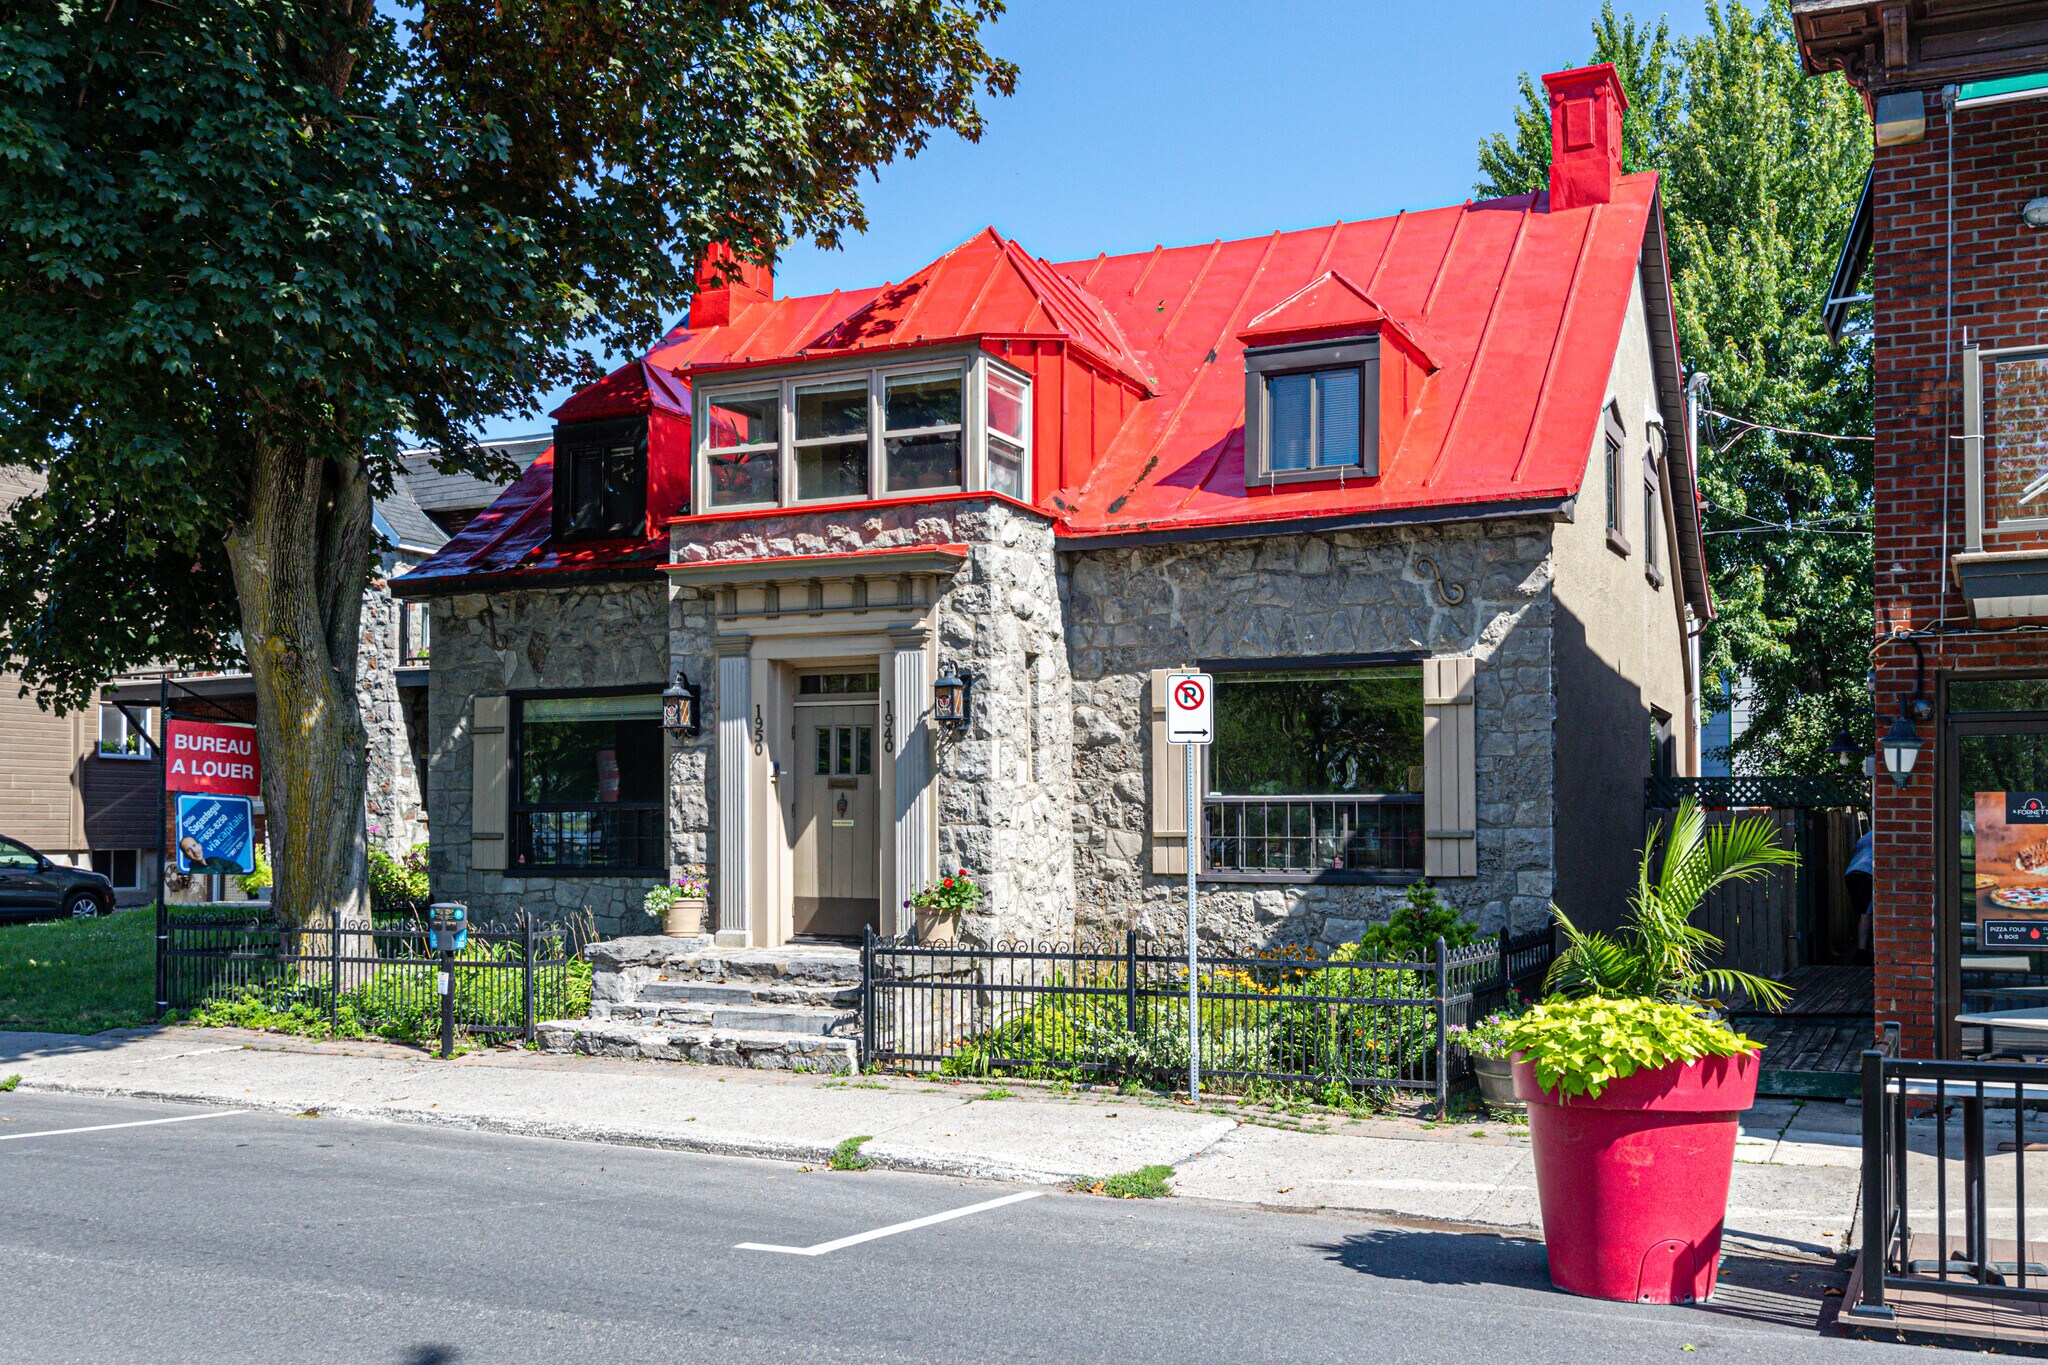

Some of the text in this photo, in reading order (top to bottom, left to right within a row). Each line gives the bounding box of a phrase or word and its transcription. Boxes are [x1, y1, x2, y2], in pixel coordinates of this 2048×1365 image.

[174, 733, 251, 755] BUREAU
[754, 704, 763, 756] 1950
[884, 700, 893, 753] 1940
[171, 758, 254, 779] A LOUER
